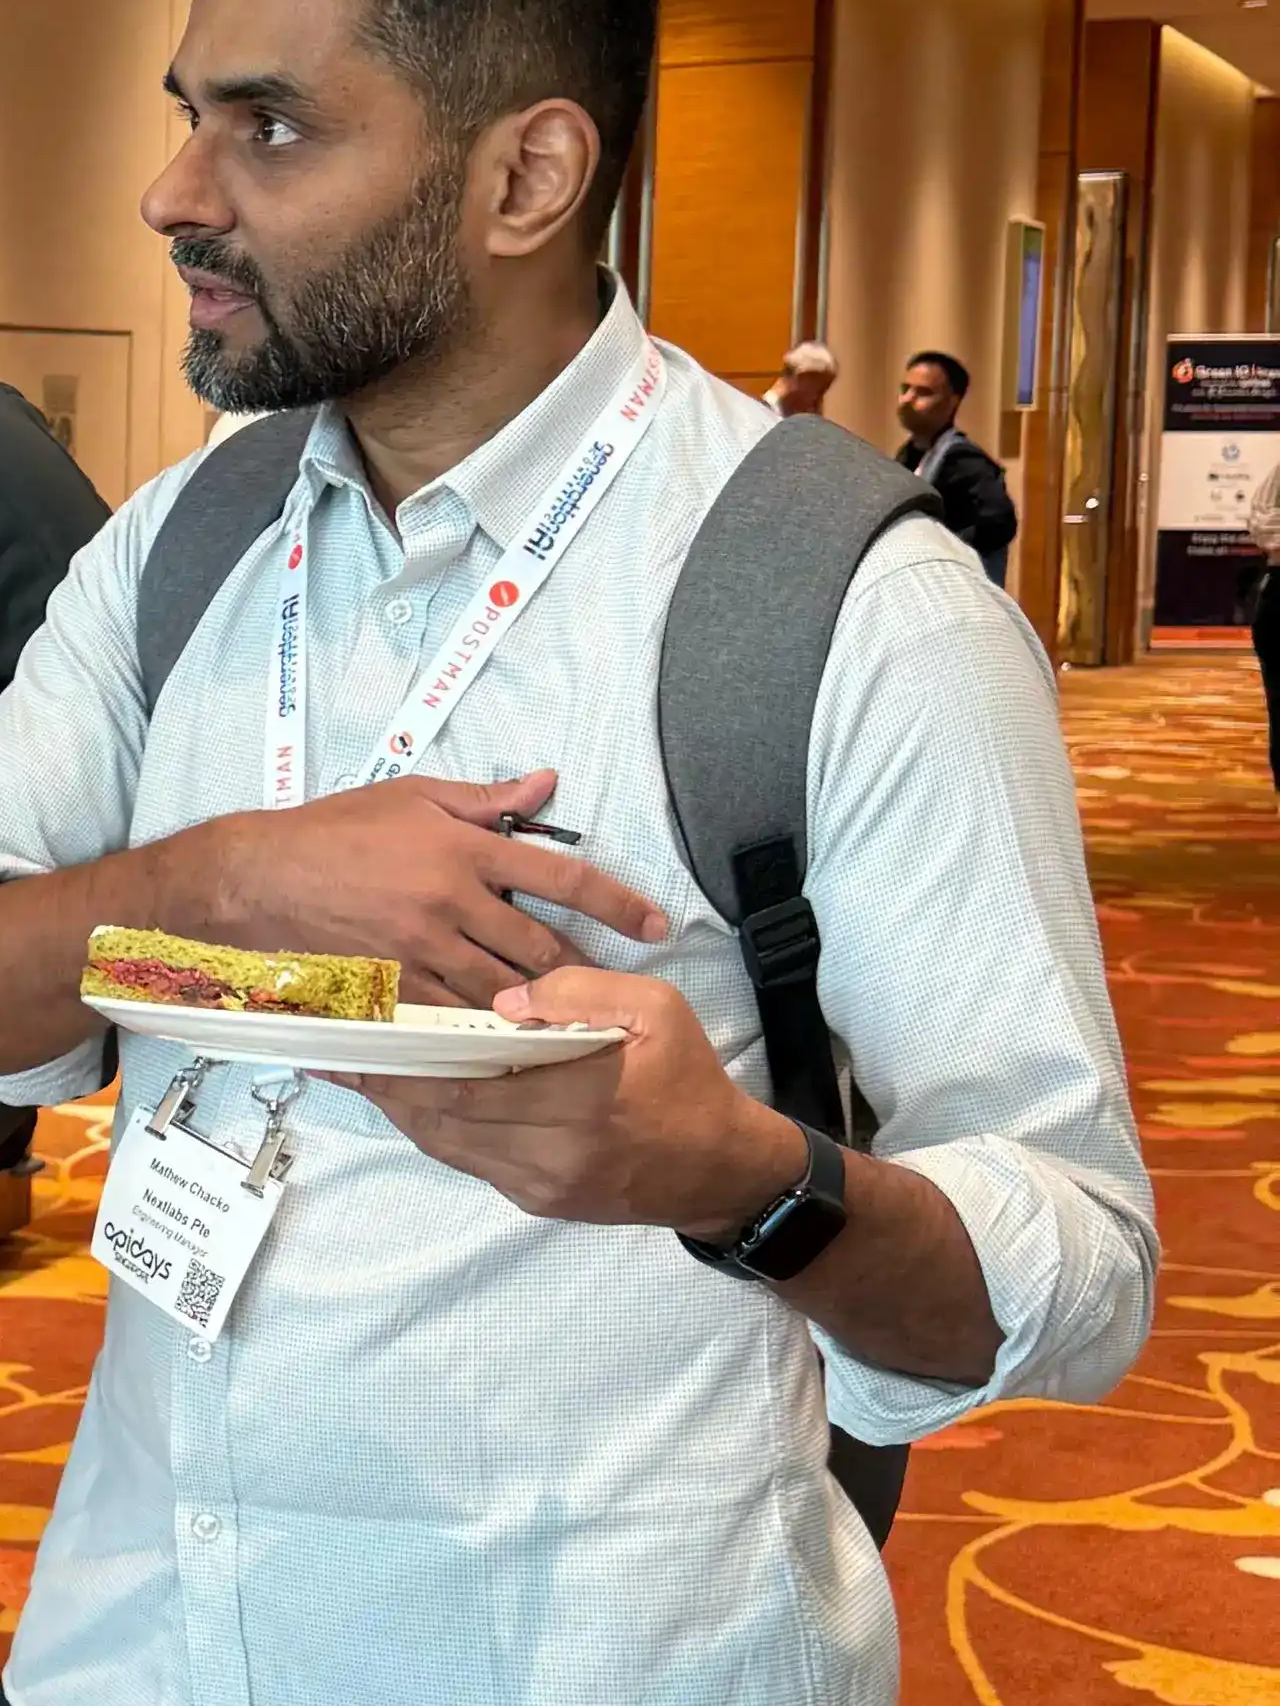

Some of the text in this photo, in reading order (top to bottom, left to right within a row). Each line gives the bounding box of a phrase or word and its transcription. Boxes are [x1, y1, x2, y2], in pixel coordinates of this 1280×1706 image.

[422, 606, 501, 709] POSTMAN
[189, 1182, 231, 1213] Chacko
[104, 1222, 172, 1280] apidays
